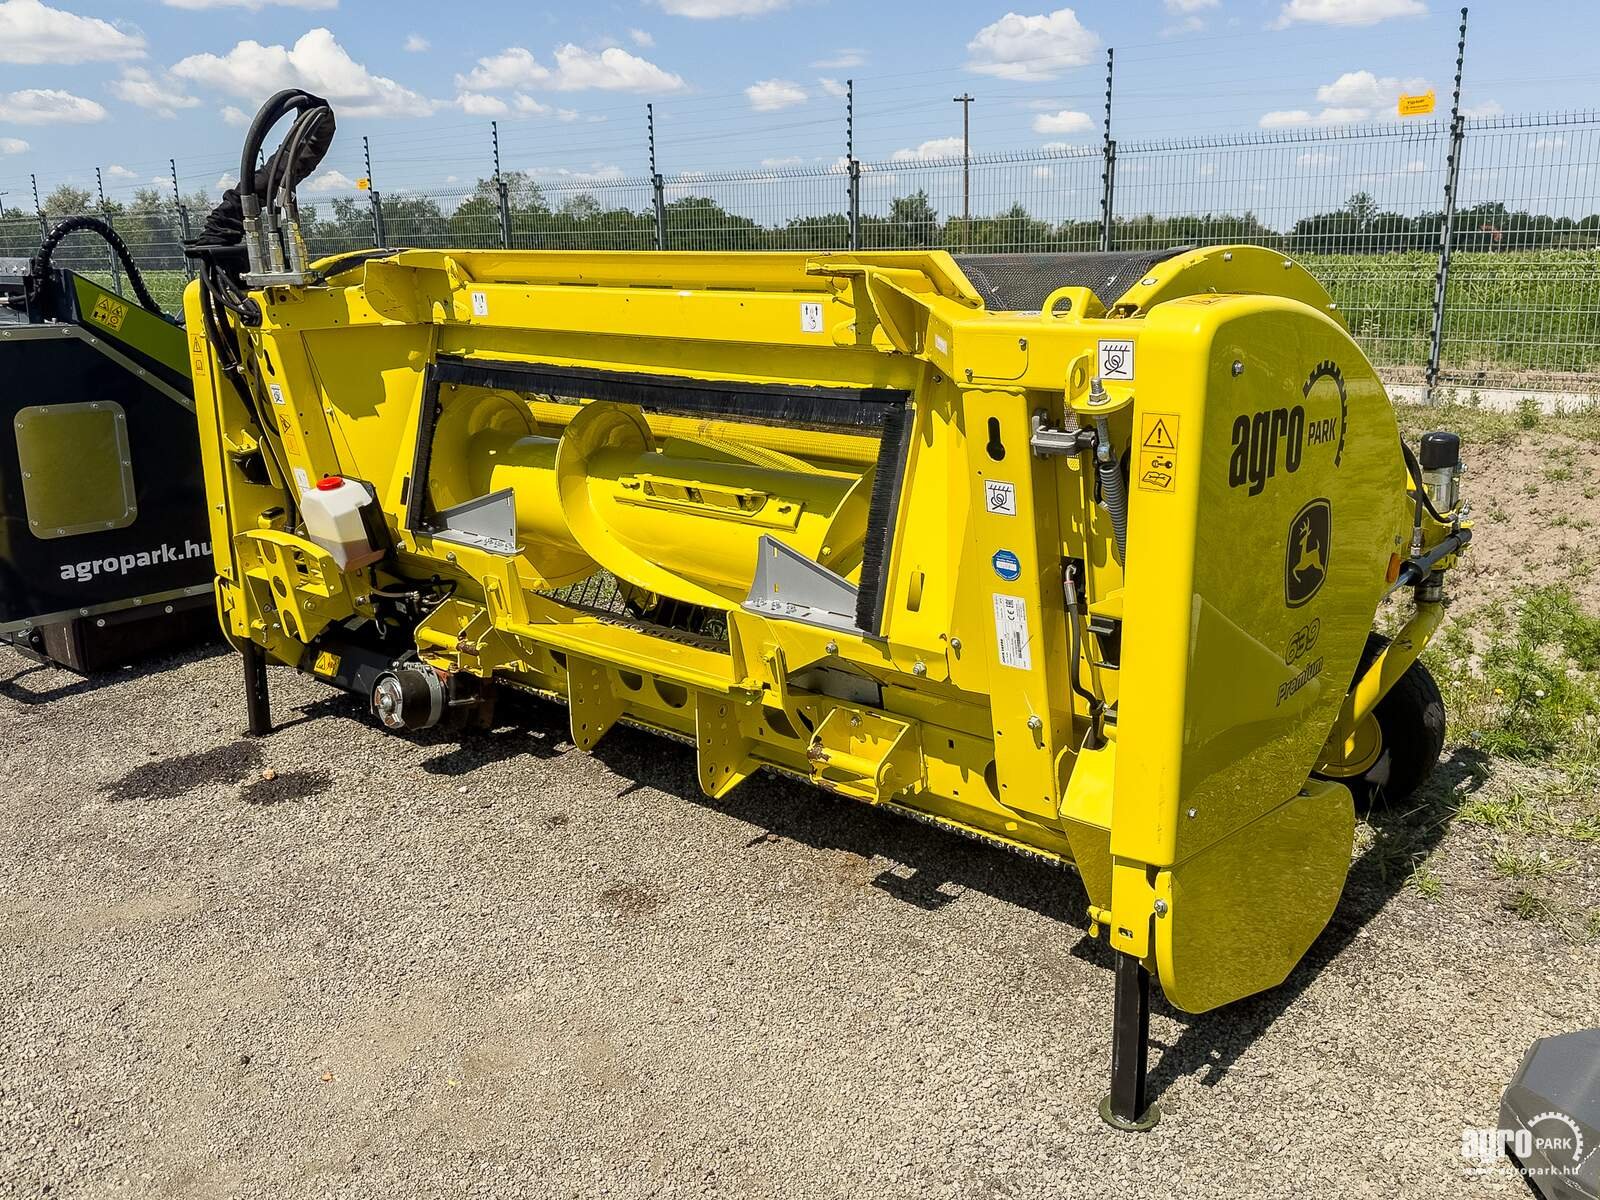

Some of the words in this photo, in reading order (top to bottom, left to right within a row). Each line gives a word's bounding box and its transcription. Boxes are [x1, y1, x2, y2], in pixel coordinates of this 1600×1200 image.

[1228, 405, 1305, 497] agro
[1307, 417, 1337, 447] PARK
[60, 539, 213, 582] agropark.hu
[1285, 617, 1321, 667] 639
[1276, 655, 1324, 708] Premium
